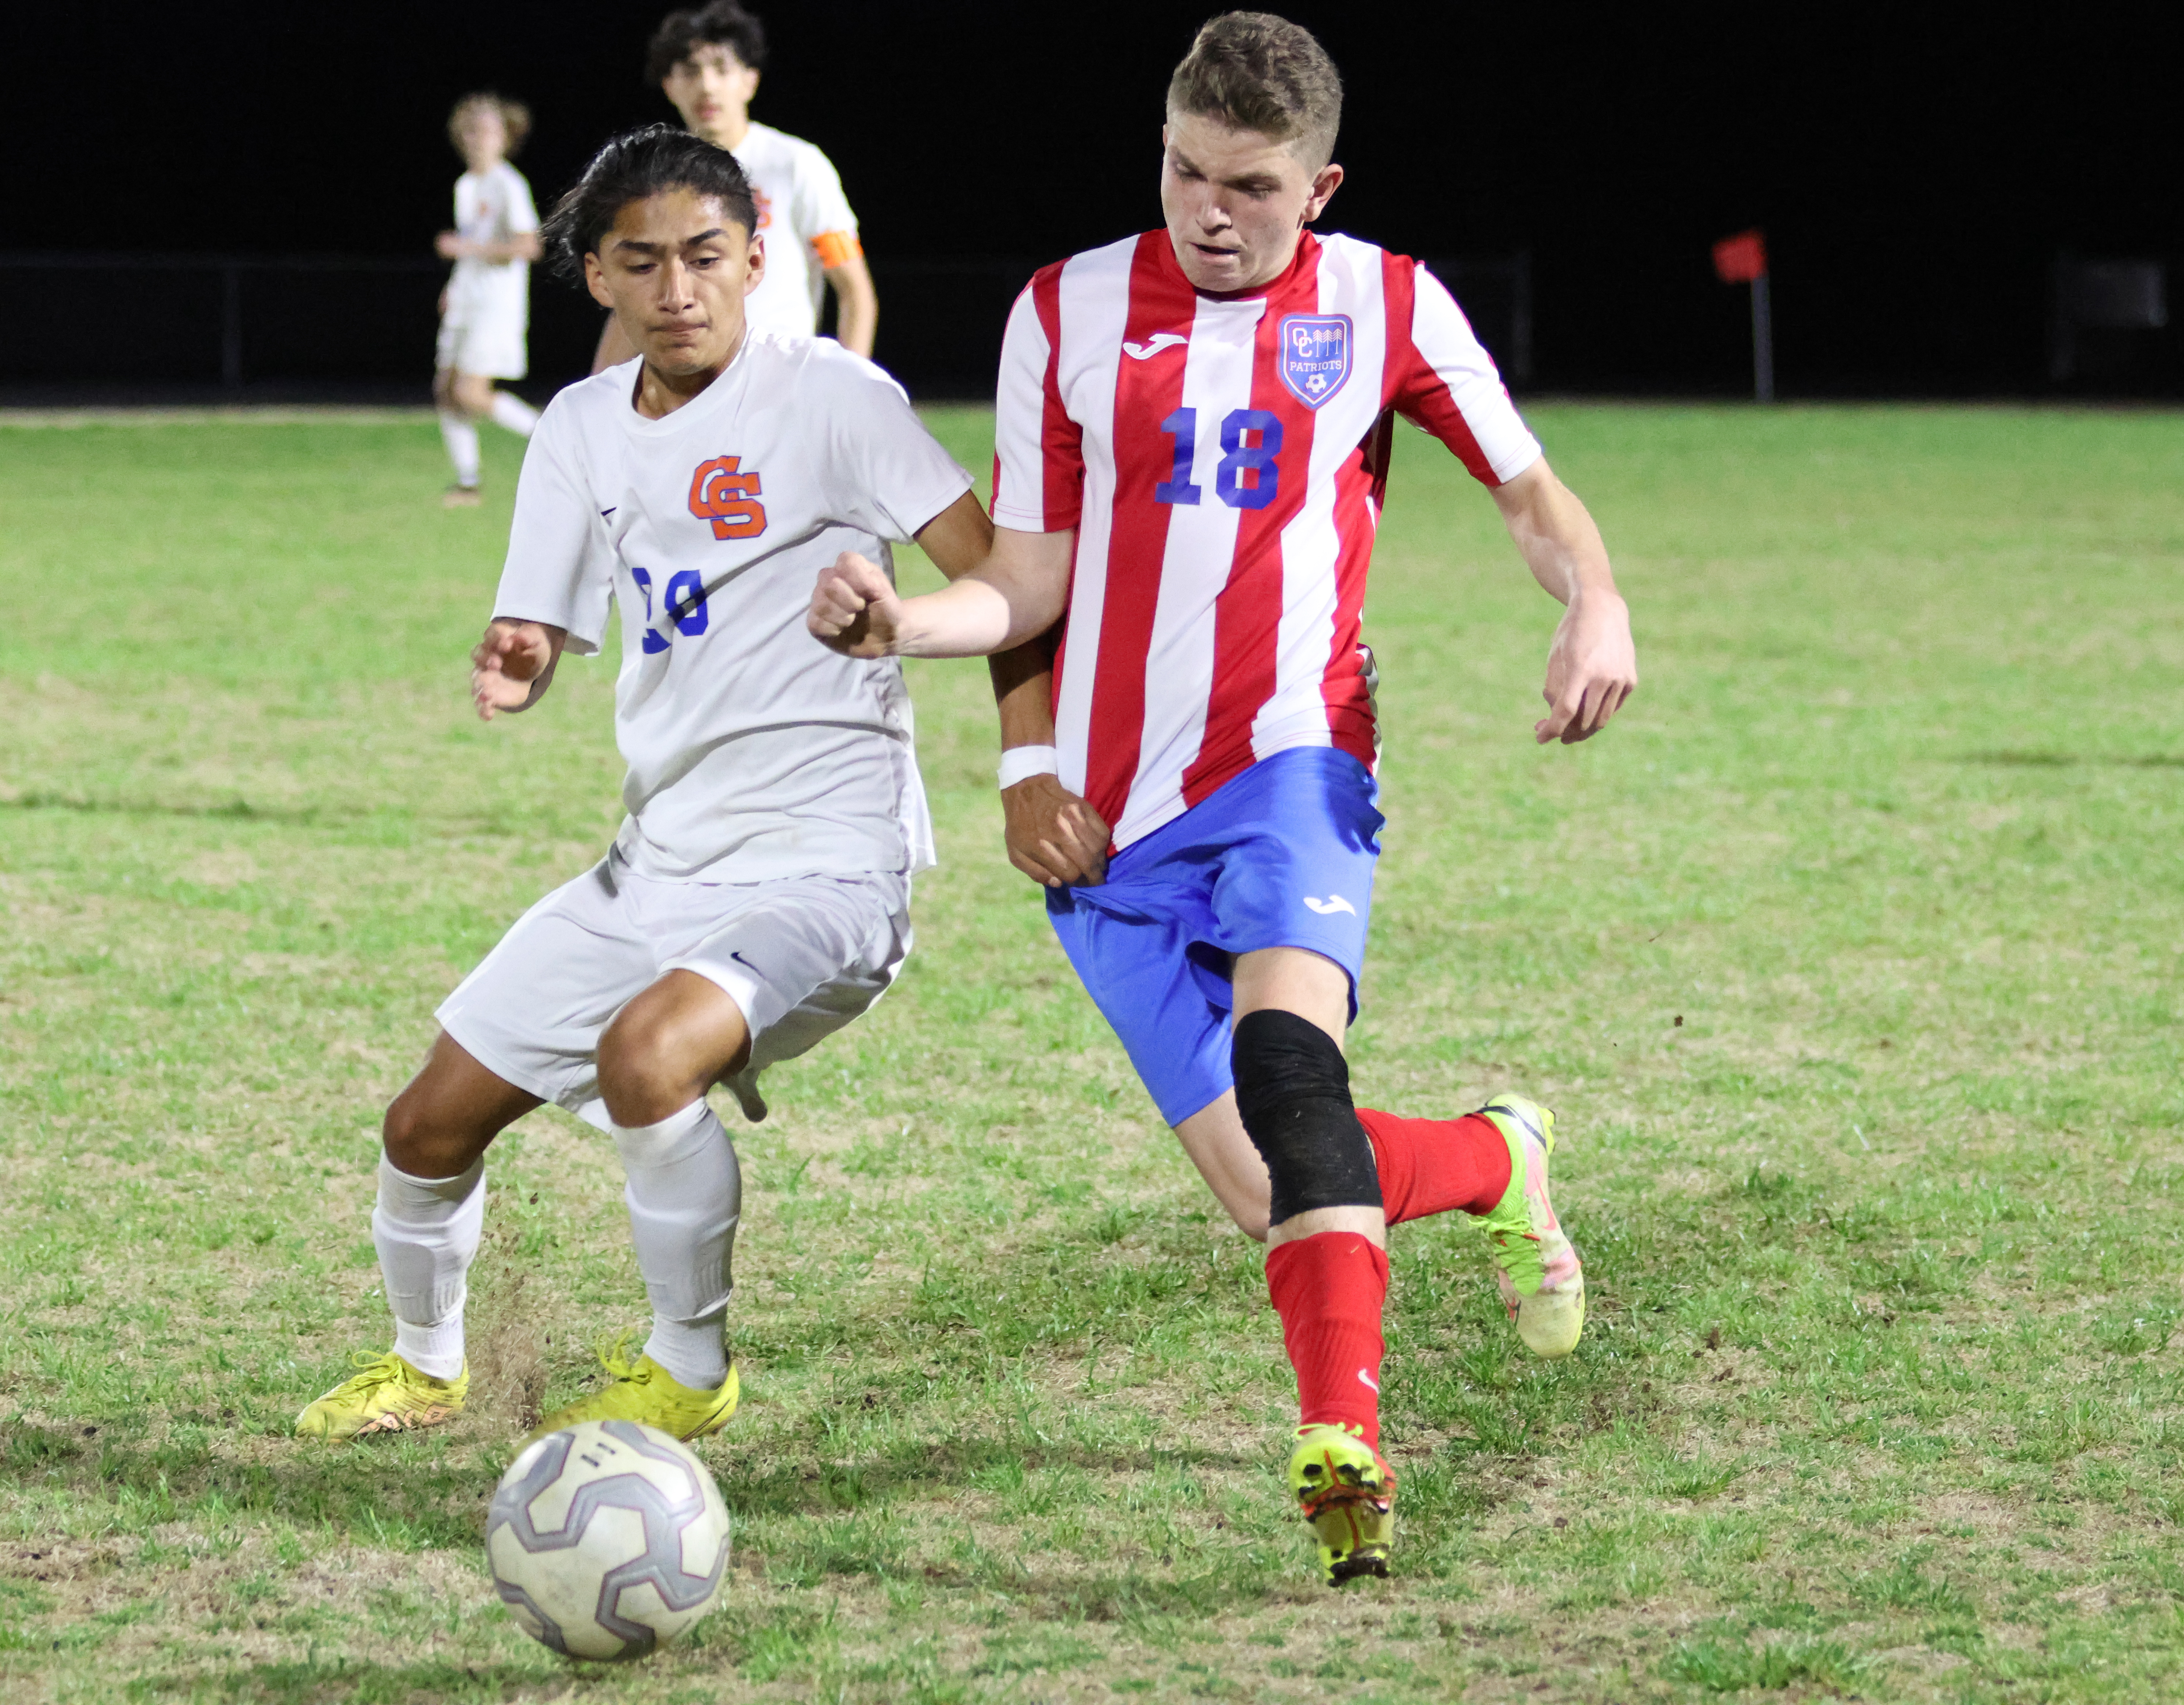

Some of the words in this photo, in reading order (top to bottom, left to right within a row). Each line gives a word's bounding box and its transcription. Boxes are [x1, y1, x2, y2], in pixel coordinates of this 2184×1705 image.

[1292, 327, 1313, 358] OC
[1289, 360, 1342, 372] PATRIOTS
[1154, 407, 1284, 510] 18
